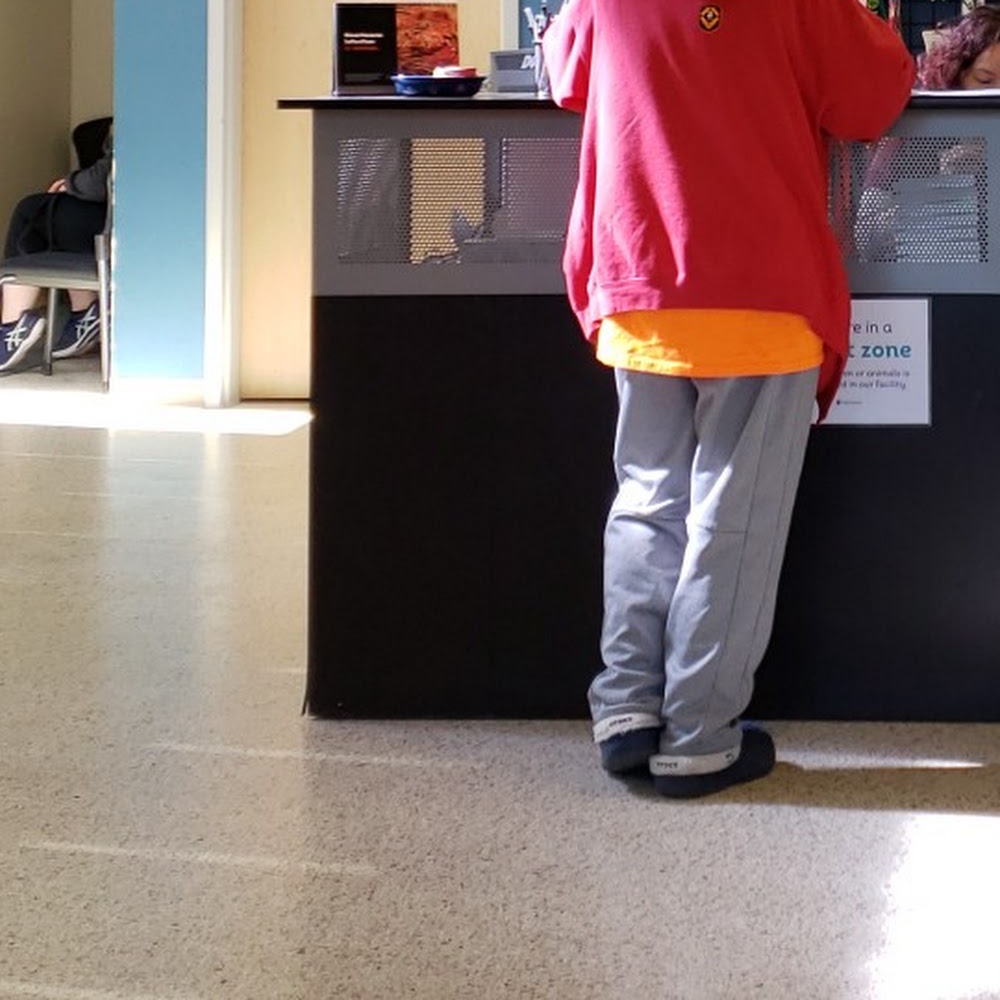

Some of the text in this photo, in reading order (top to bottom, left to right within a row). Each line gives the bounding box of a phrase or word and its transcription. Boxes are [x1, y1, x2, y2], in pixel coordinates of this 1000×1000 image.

[866, 321, 879, 334] in
[883, 323, 893, 334] a
[861, 345, 912, 358] zone
